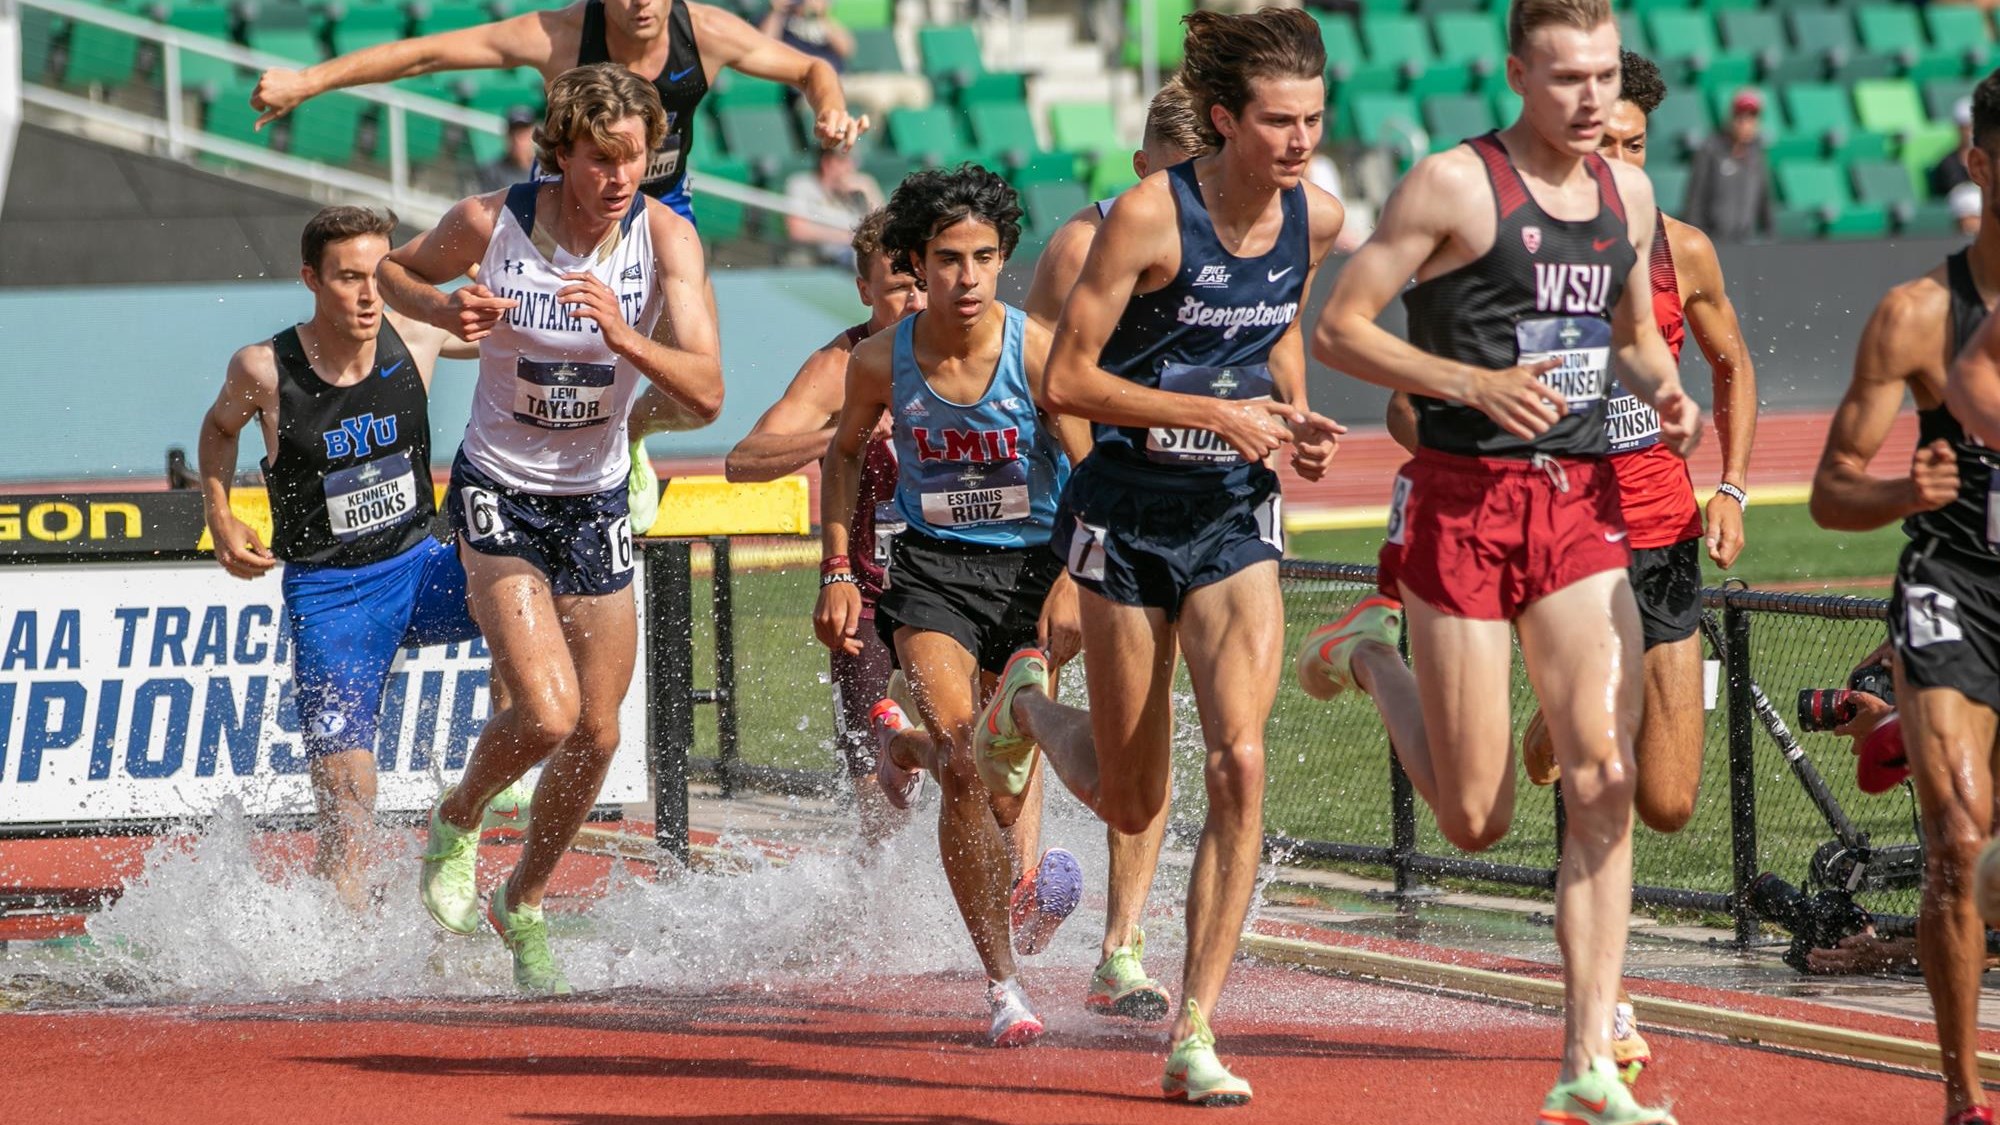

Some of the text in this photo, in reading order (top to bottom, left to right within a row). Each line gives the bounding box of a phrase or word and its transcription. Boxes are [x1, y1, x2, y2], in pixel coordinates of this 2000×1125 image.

[1195, 274, 1232, 282] EAST
[1201, 265, 1226, 274] BIG
[1533, 263, 1612, 313] WSU
[1177, 295, 1298, 340] Georgetown
[526, 394, 601, 419] TAYLOR
[550, 387, 577, 400] LEVI
[322, 412, 397, 459] BYU
[912, 425, 1020, 463] LMU
[346, 480, 399, 508] KENNETH
[947, 489, 1003, 507] ESTANIS
[344, 492, 406, 529] ROOKS
[470, 490, 494, 536] 6
[951, 503, 1003, 523] RUIZ
[617, 519, 631, 568] 6
